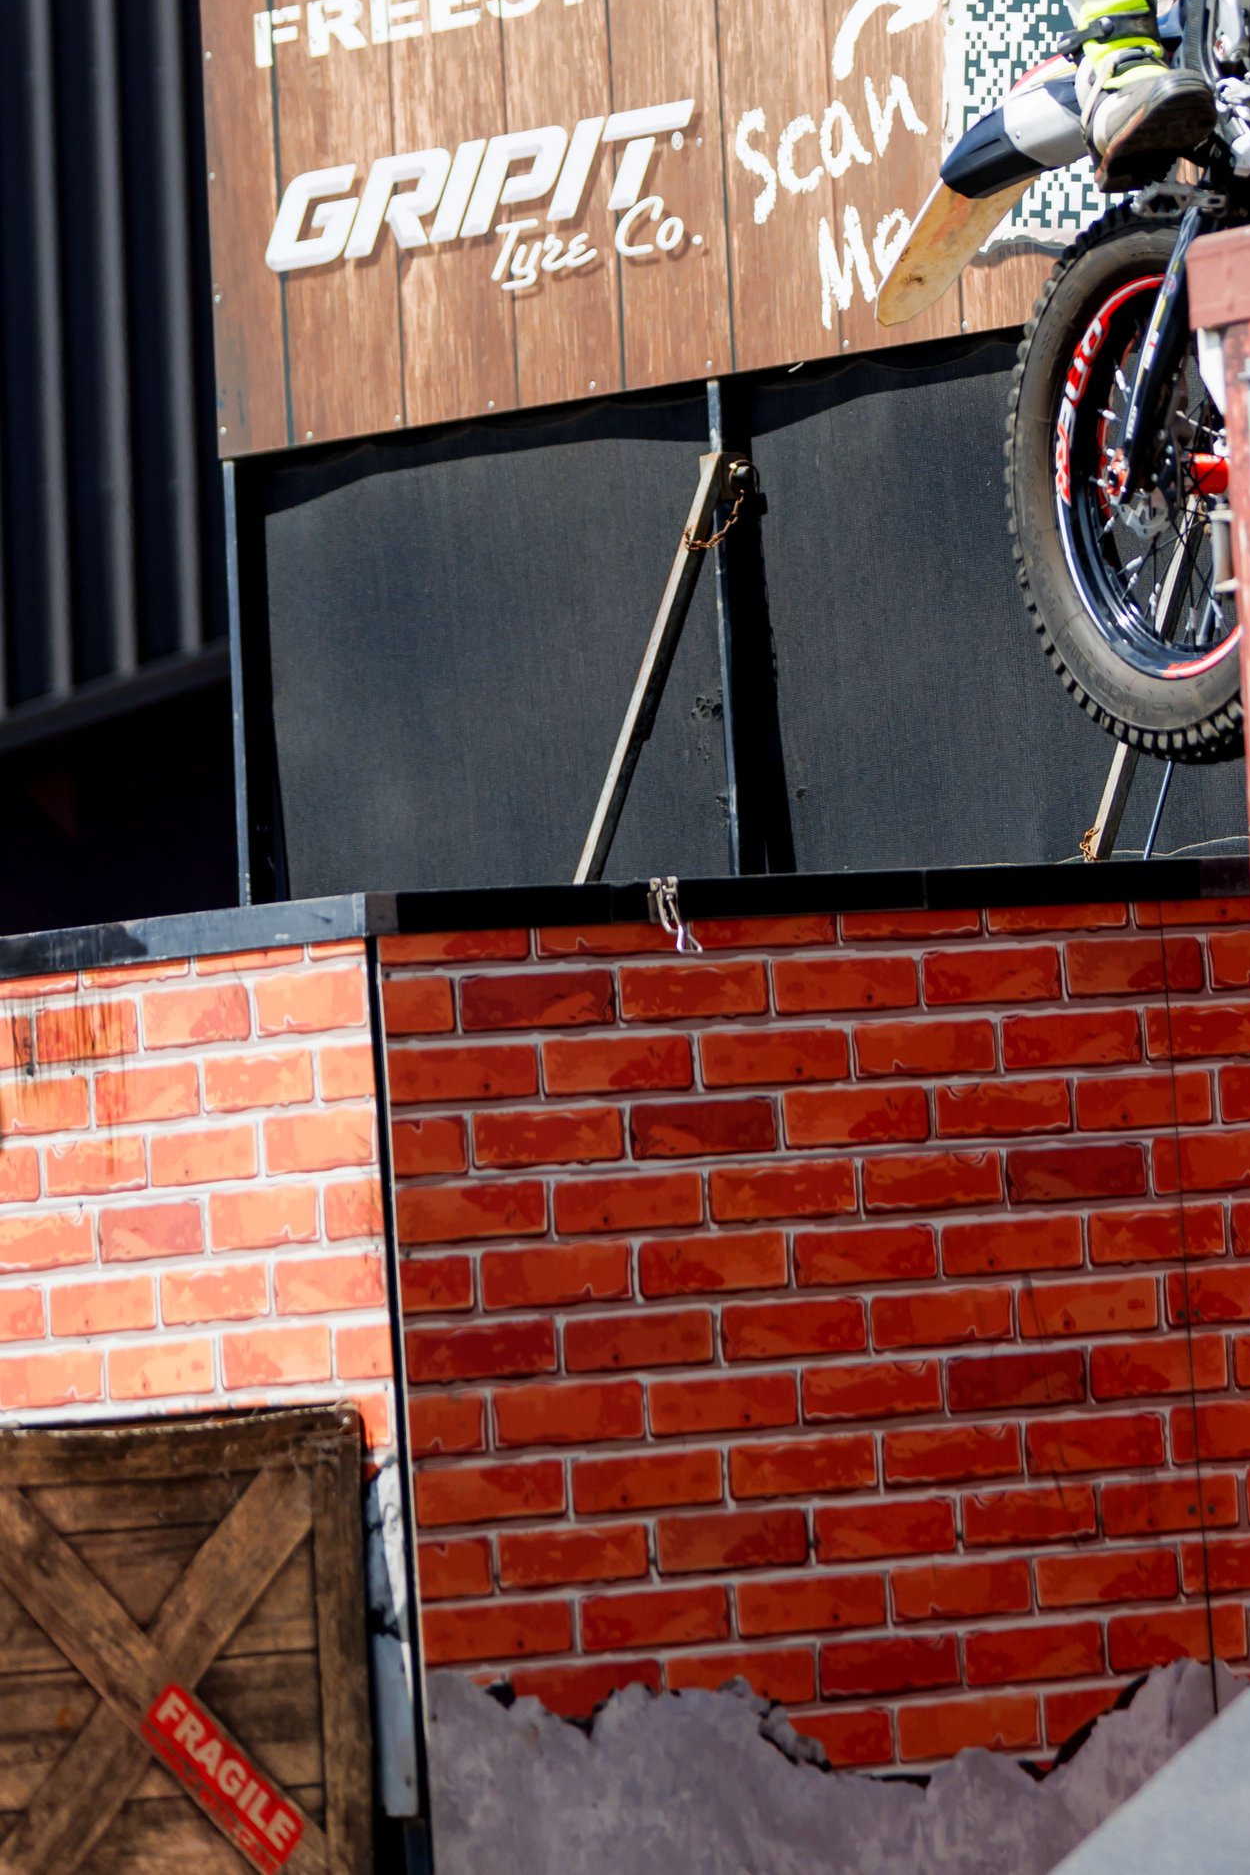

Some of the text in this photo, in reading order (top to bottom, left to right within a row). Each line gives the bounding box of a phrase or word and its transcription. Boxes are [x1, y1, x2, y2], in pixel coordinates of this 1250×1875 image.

[264, 98, 695, 272] GRIPIT
[734, 75, 927, 224] Scan
[491, 195, 703, 291] Tyre Co.
[818, 204, 911, 330] Me
[155, 1691, 296, 1852] FRAGILE
